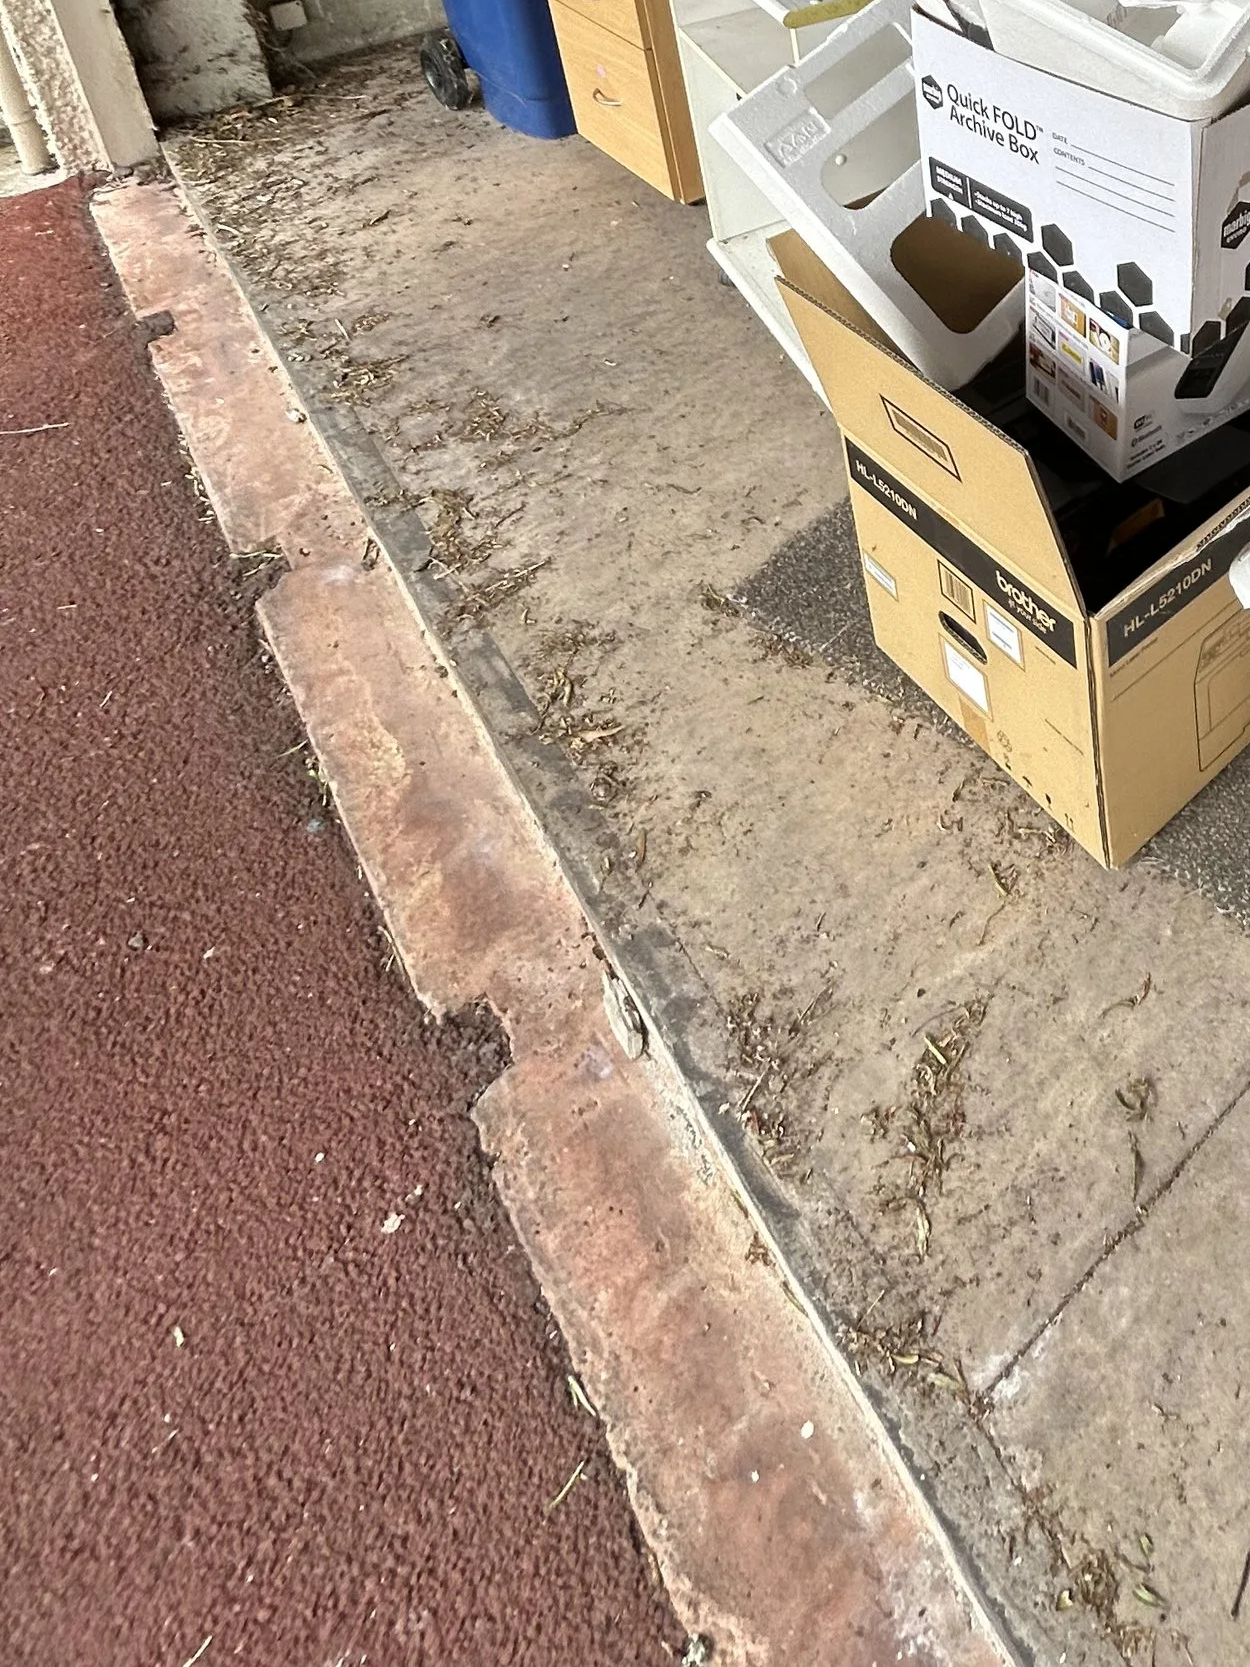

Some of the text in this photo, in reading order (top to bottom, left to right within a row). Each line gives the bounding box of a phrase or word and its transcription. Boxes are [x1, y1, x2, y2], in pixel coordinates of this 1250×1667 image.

[947, 84, 990, 120] Quick
[950, 105, 1040, 165] Archive Box
[1052, 132, 1068, 145] DATE
[1053, 147, 1085, 166] CONTENTS
[855, 459, 918, 521] HL-L5210DN
[995, 570, 1057, 632] brother
[1123, 558, 1212, 637] HL-L5210DN
